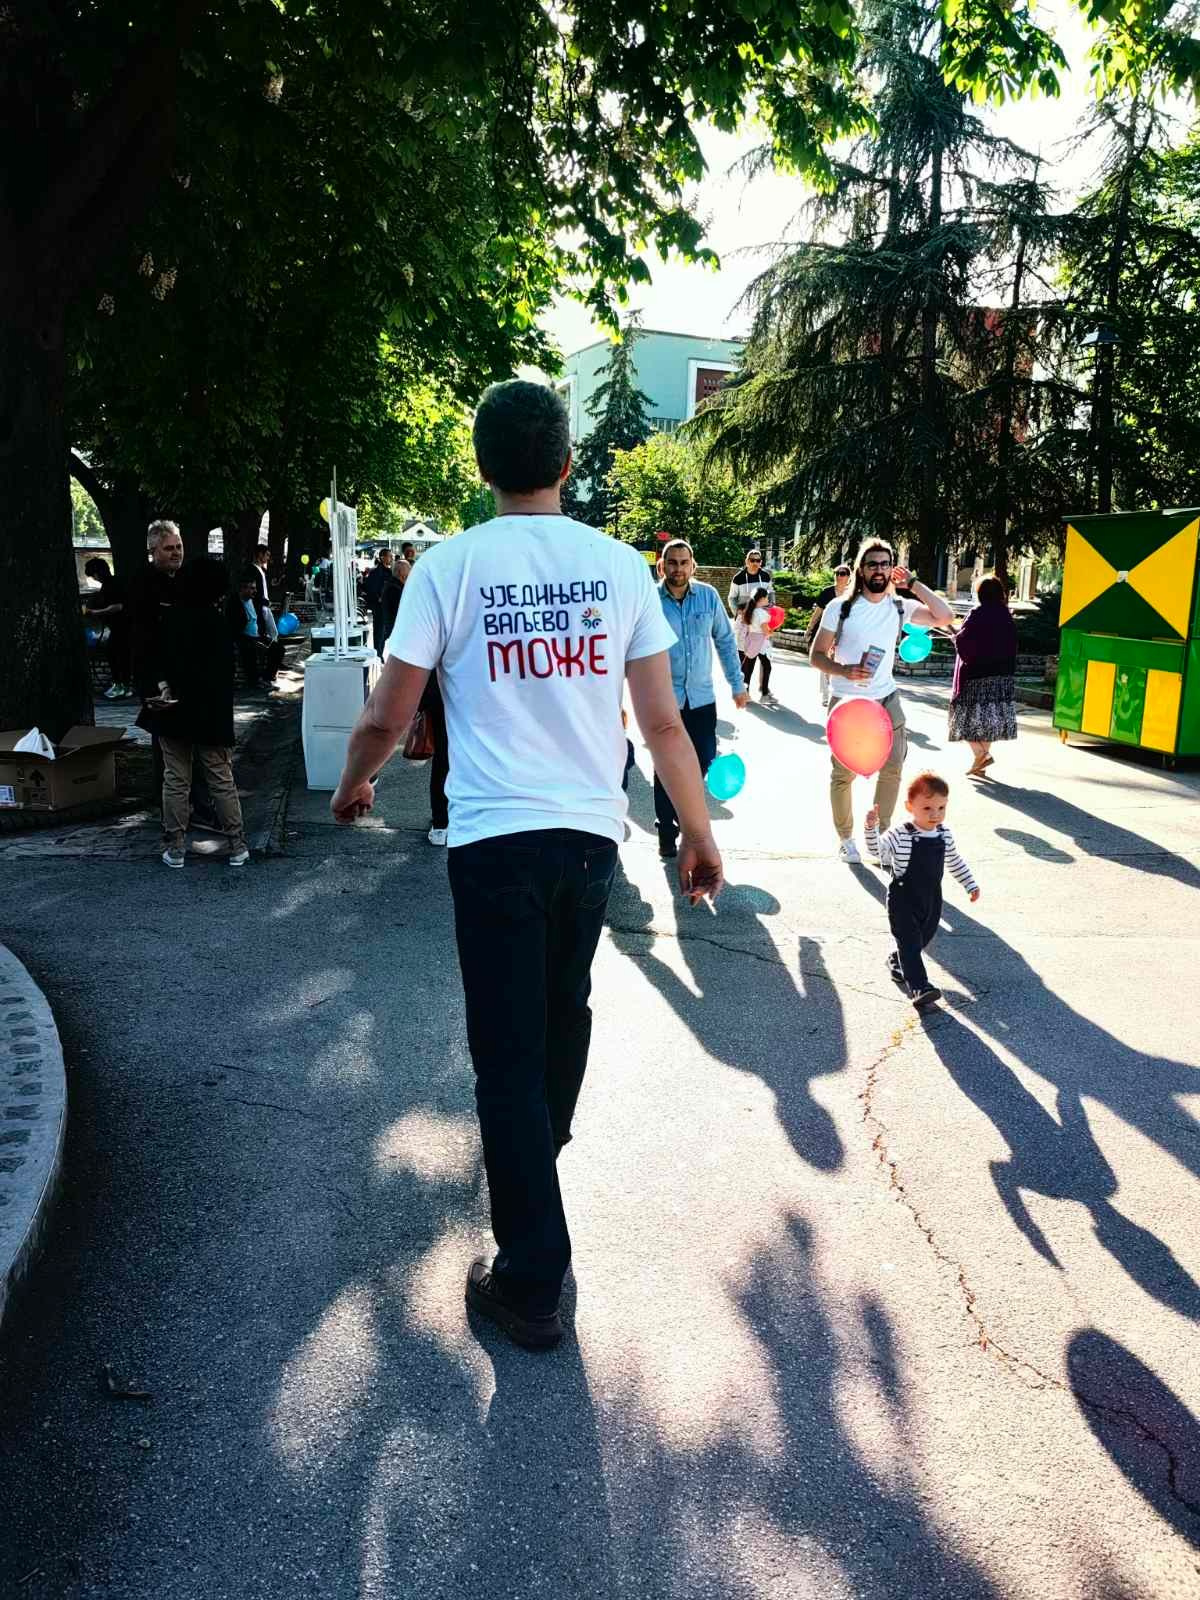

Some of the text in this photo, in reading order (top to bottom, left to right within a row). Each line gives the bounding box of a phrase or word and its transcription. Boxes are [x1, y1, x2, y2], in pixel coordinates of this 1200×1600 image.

[480, 580, 607, 608] УЈЕДИЊЕНО
[483, 610, 569, 635] ВАЉЕВО
[487, 634, 608, 682] МОЖЕ
